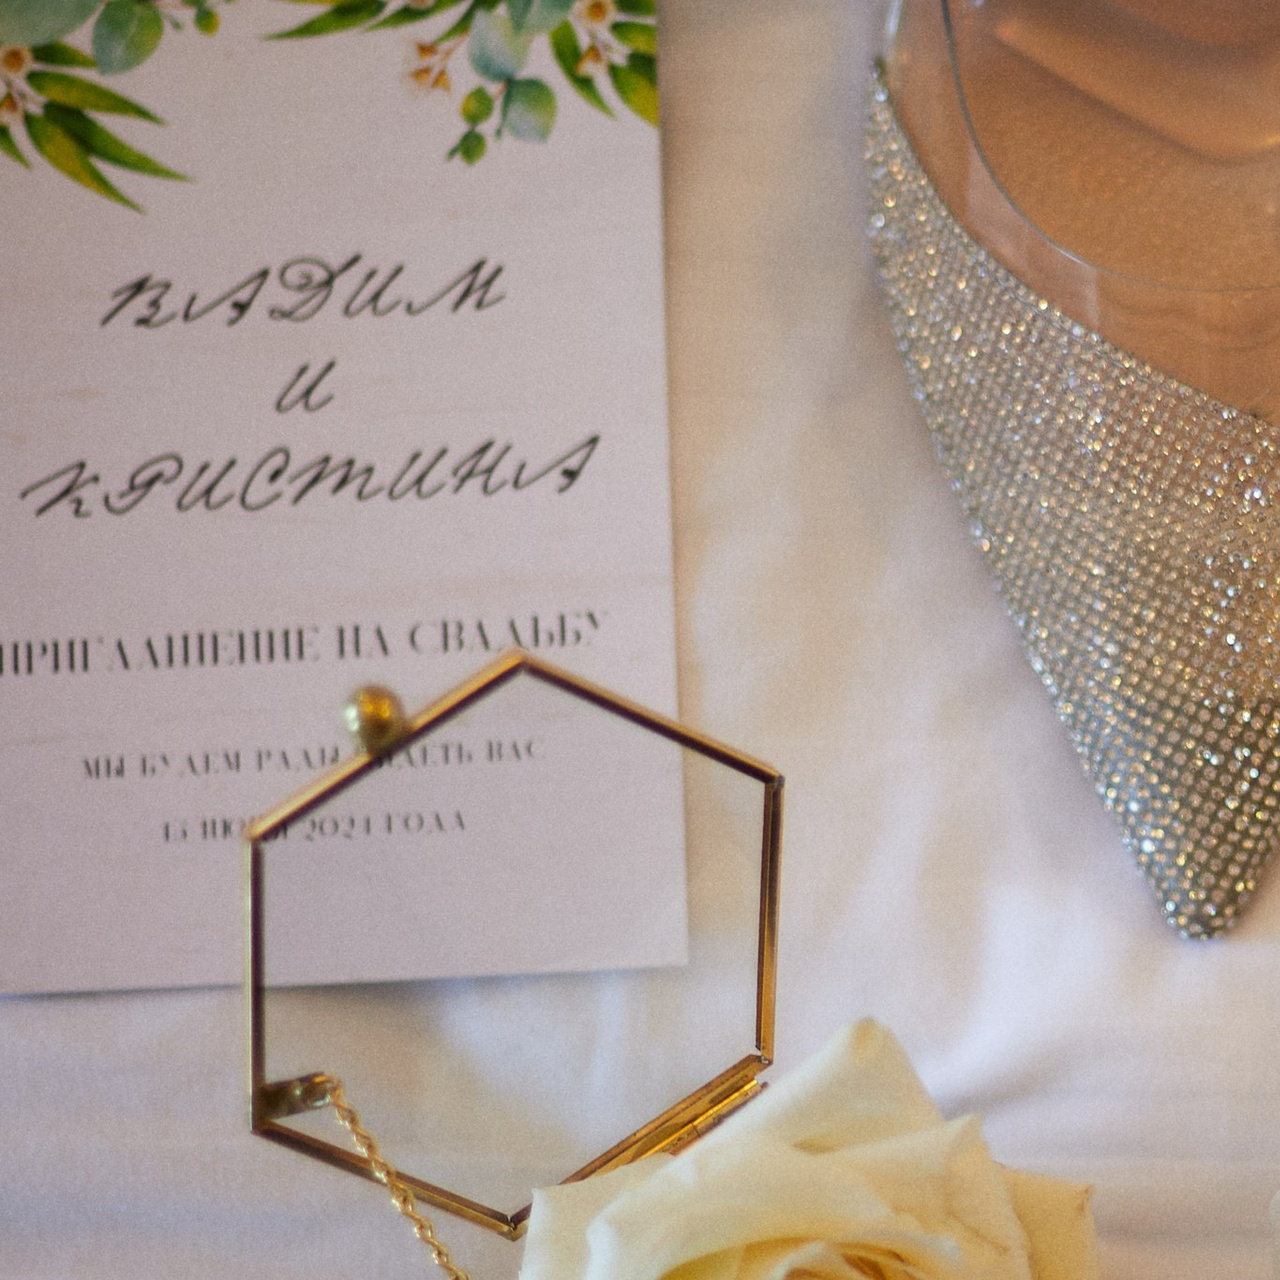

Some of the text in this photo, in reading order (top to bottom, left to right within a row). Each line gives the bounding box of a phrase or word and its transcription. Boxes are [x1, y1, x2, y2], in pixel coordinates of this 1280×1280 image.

[336, 623, 390, 658] НА
[408, 609, 609, 654] СВАДЬБУ
[83, 756, 125, 780] МЫ
[139, 747, 241, 778] БУДЕМ
[486, 739, 540, 763] ВАС
